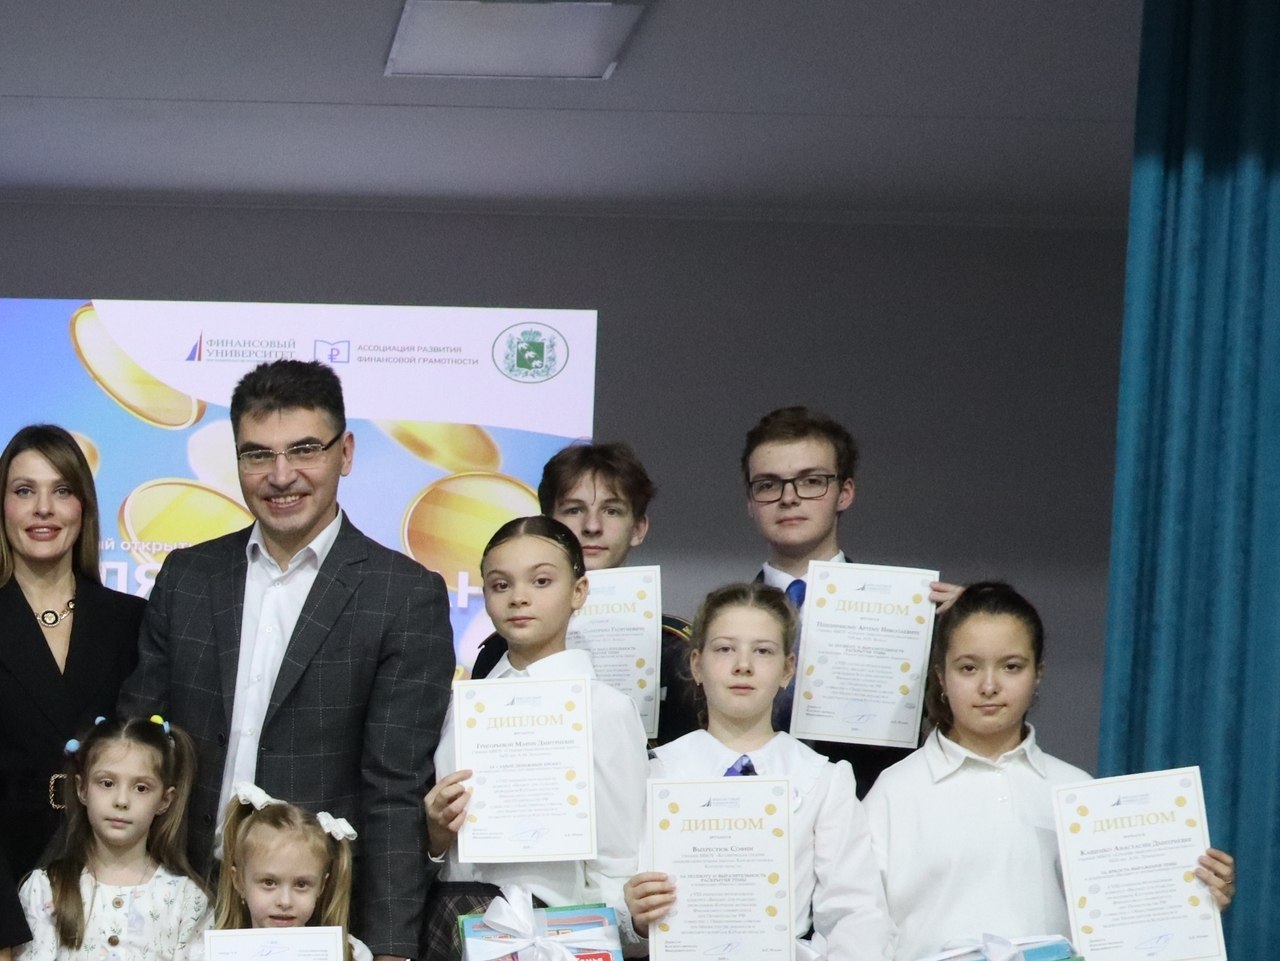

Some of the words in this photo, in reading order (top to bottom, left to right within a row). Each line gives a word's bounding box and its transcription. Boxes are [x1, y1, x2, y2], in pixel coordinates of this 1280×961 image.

[206, 339, 296, 349] ФИНАНСОВЫЙ
[357, 345, 416, 353] АССОЦИАЦИЯ
[206, 349, 296, 360] УНИВЕРСИТЕТ
[357, 356, 416, 364] ФИНАНСОВОЙ
[835, 600, 910, 616] ДИПЛОМ
[487, 714, 564, 730] ДИПЛОМ
[680, 818, 765, 832] ДИПЛОМ
[1092, 810, 1177, 833] ДИПЛОМ
